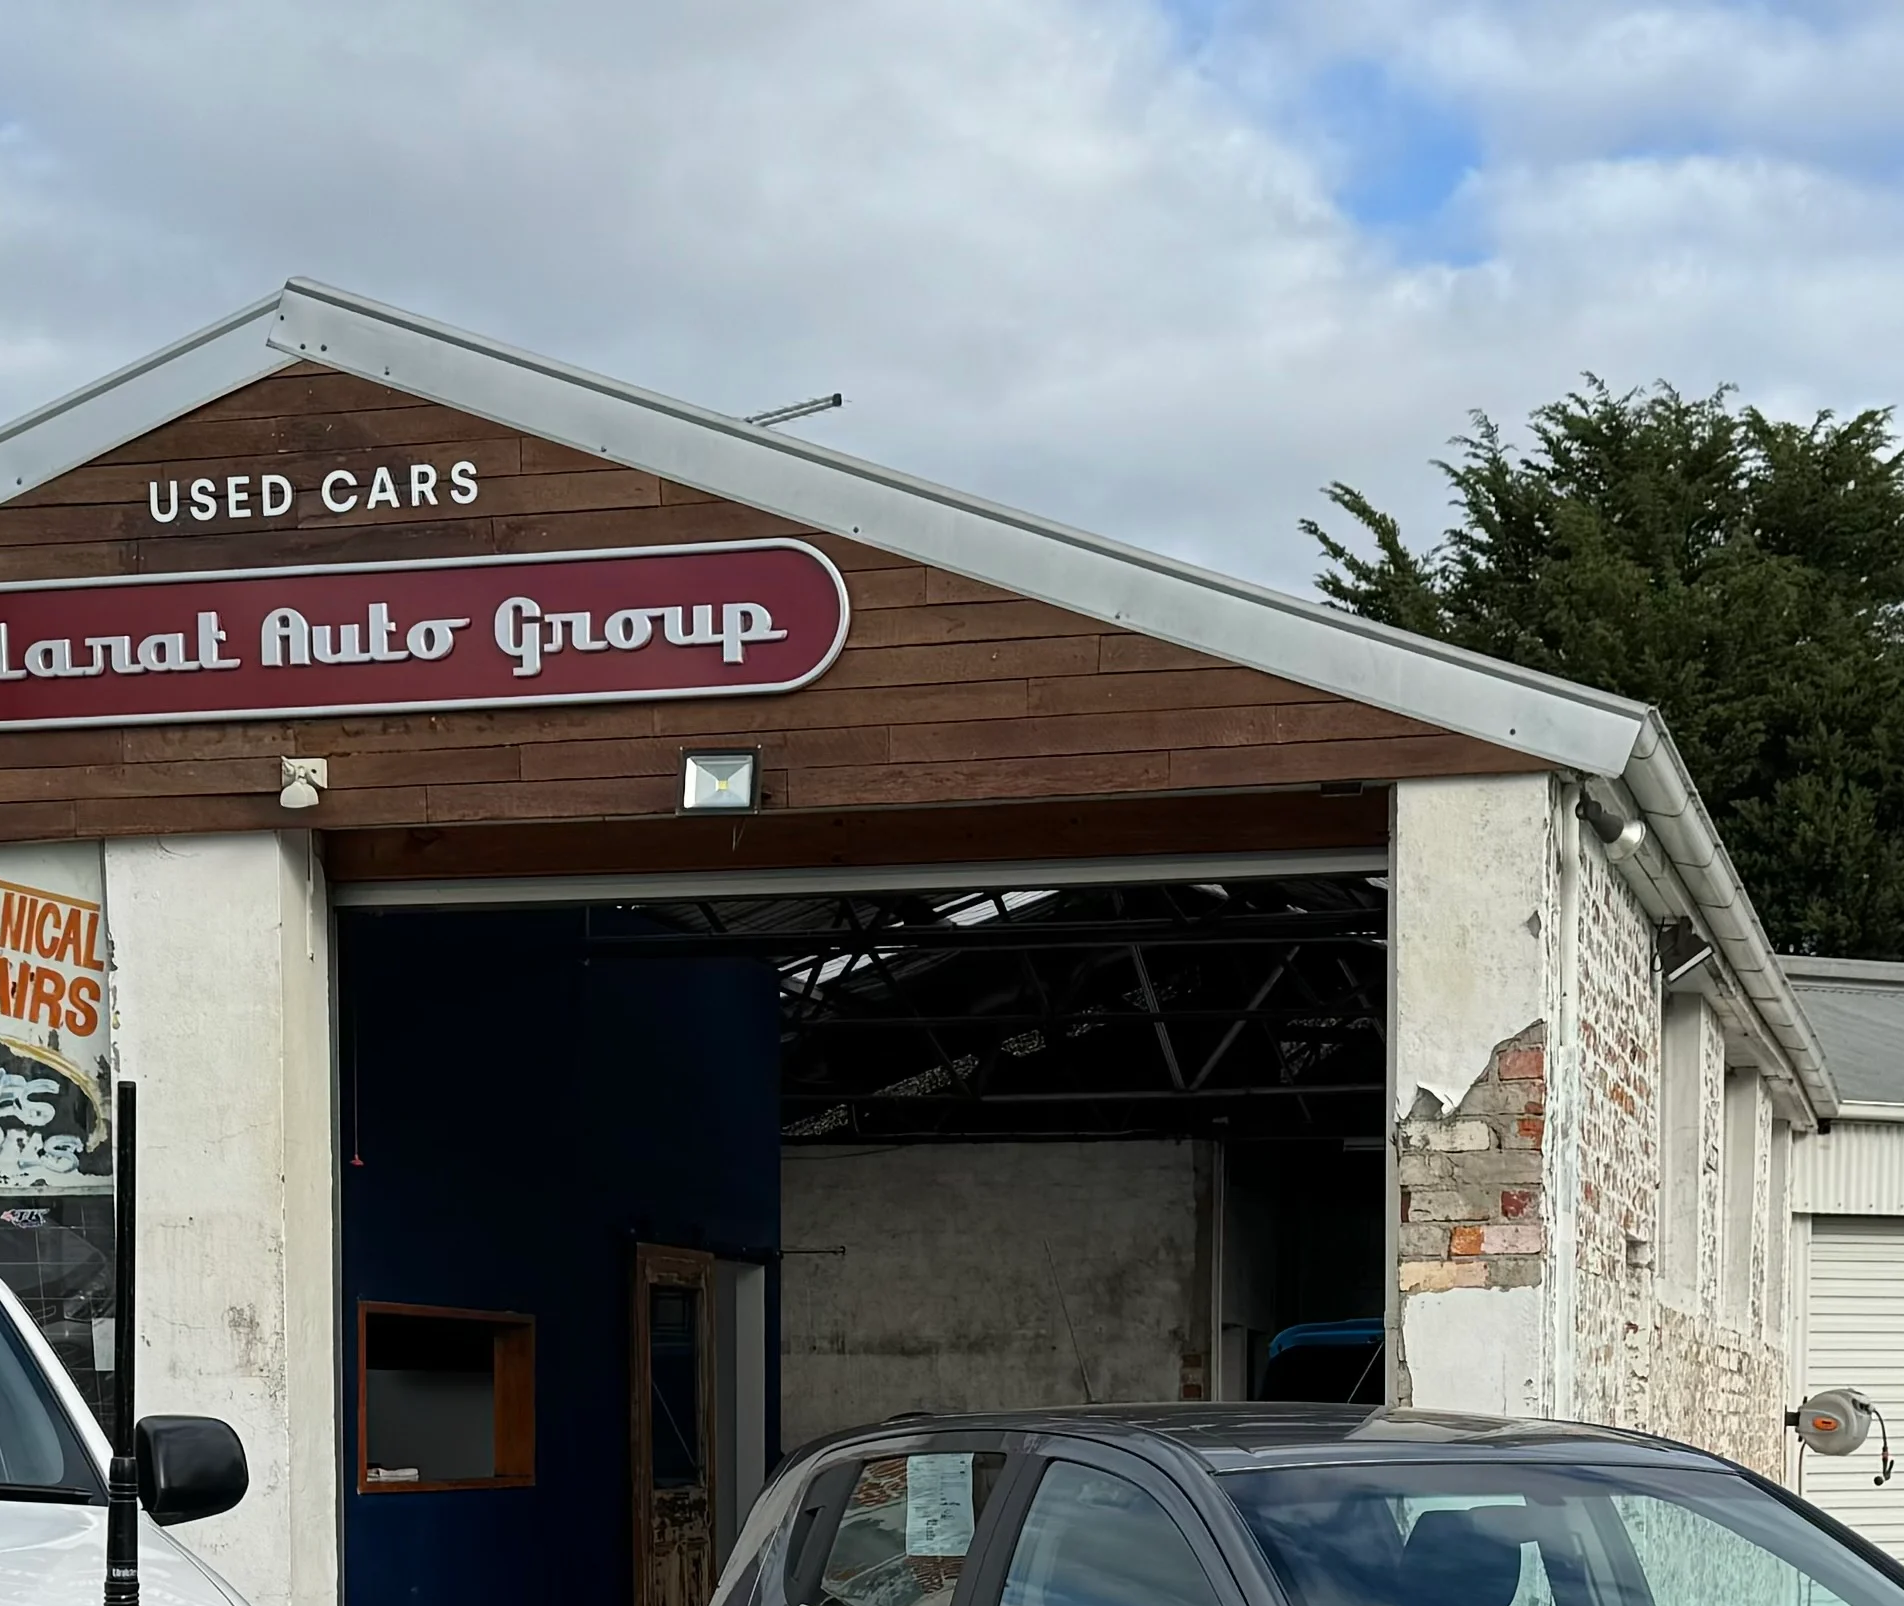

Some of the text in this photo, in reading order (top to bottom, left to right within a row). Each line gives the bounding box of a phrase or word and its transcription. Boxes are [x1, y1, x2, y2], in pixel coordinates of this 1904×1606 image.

[149, 461, 480, 524] USED CARS
[261, 601, 471, 667] Auto
[495, 595, 788, 677] Group
